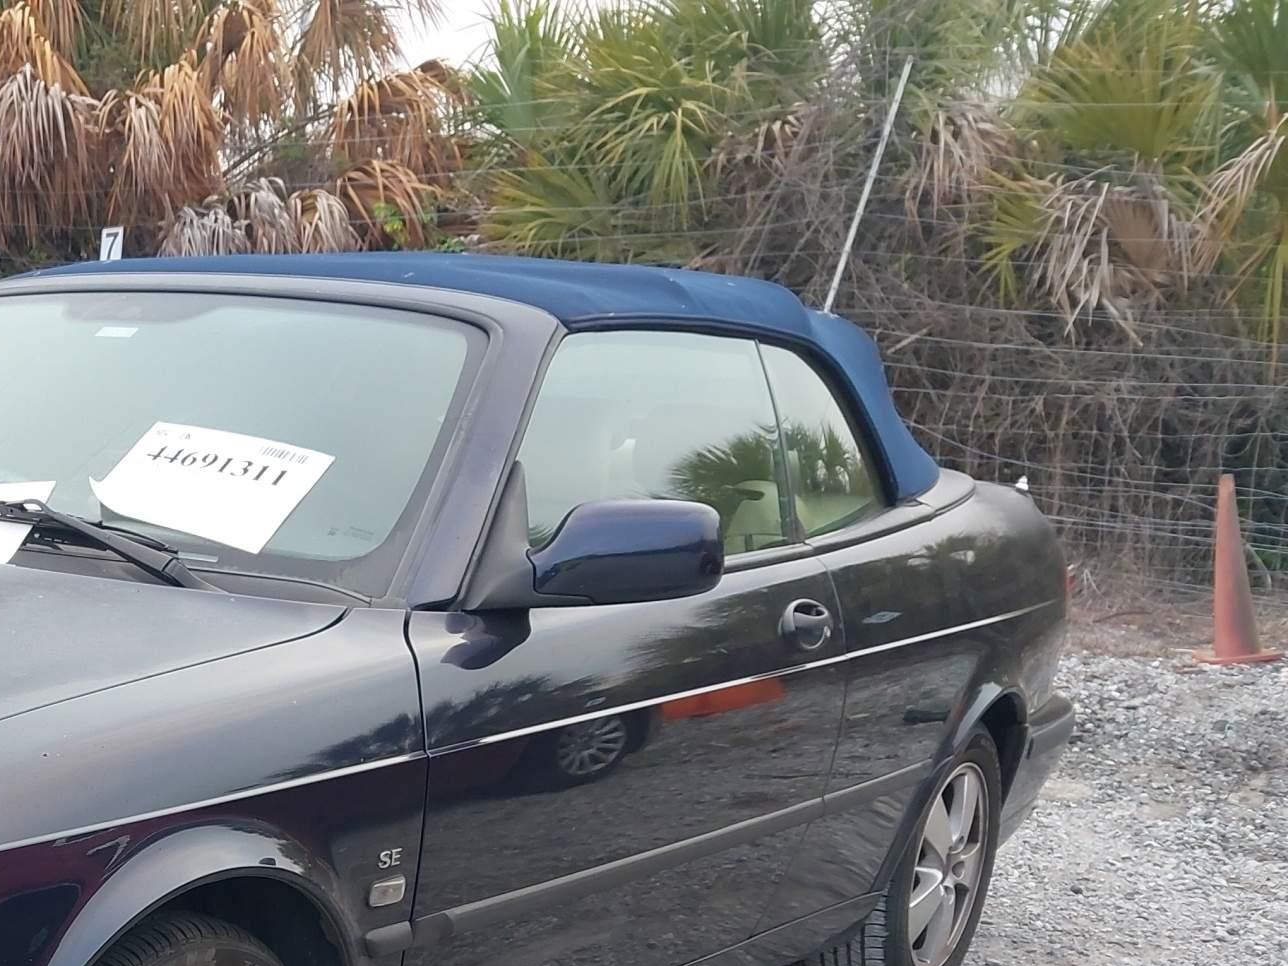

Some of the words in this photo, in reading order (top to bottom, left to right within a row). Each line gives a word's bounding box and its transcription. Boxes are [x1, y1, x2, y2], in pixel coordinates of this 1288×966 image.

[105, 231, 119, 260] 7
[146, 445, 288, 486] 44691311
[377, 846, 403, 869] SE
